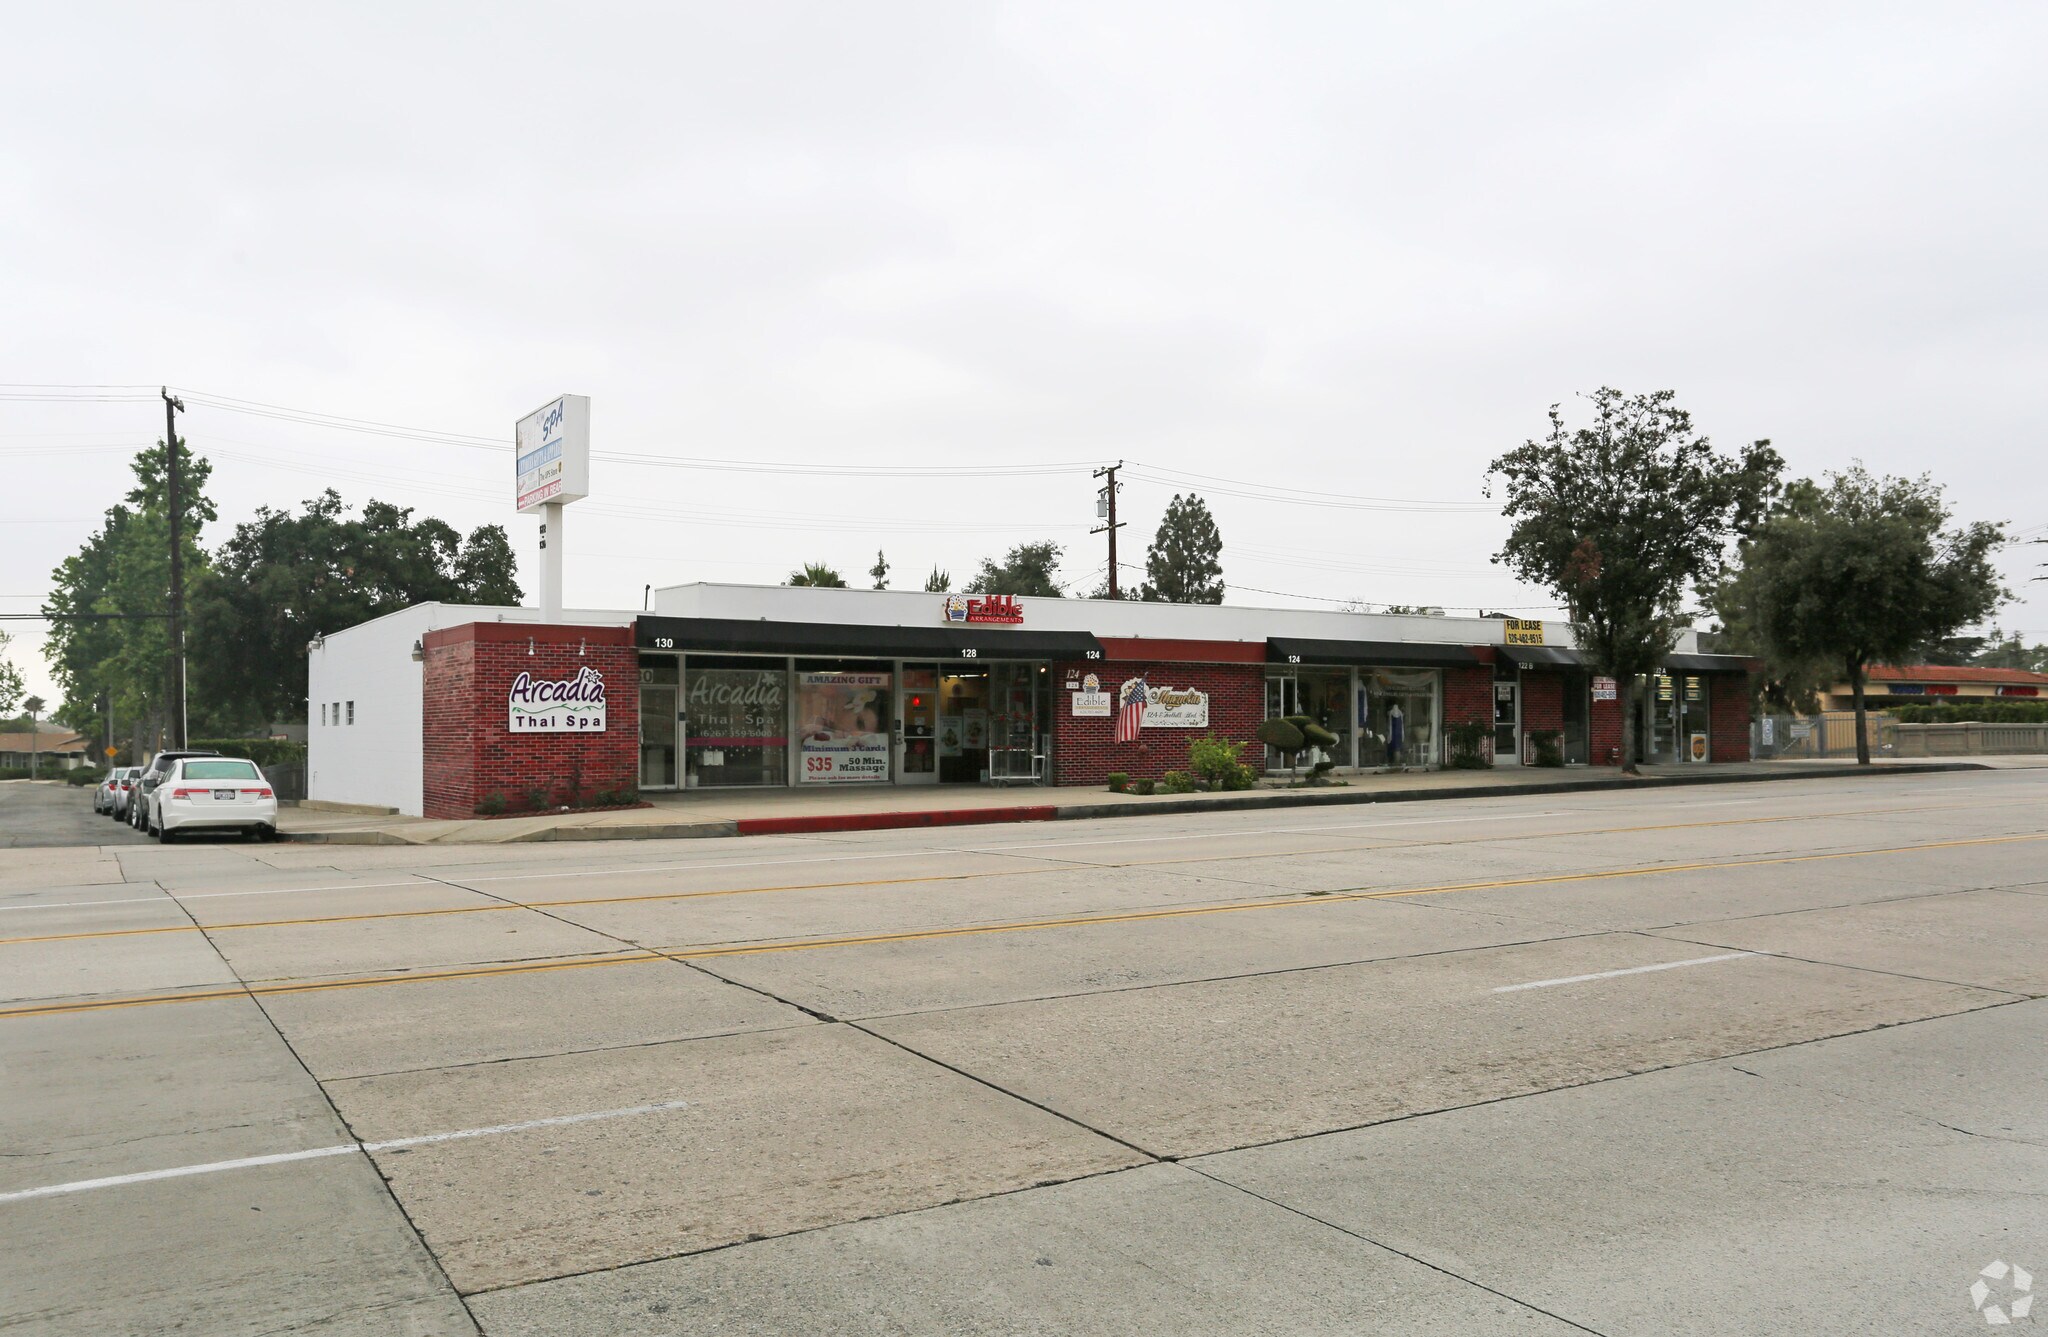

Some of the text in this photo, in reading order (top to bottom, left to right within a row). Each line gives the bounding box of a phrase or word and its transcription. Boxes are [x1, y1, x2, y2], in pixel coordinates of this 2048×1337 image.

[543, 400, 563, 441] SPA
[968, 594, 1023, 616] Edible
[1507, 620, 1541, 631] FOR LEASE
[655, 638, 673, 648] 130
[962, 649, 977, 658] 128
[1086, 651, 1100, 659] 124
[1288, 655, 1300, 663] 124
[1067, 669, 1079, 679] 124
[807, 676, 882, 684] AMAZING GIFT
[511, 669, 604, 703] Arcadia
[690, 672, 780, 705] Arcadia
[1076, 695, 1106, 706] Edible
[1148, 690, 1201, 711] Magnolia
[515, 715, 601, 729] Thai Spa
[698, 713, 774, 727] Thai Spa
[807, 757, 832, 773] $35
[839, 764, 885, 772] Massage
